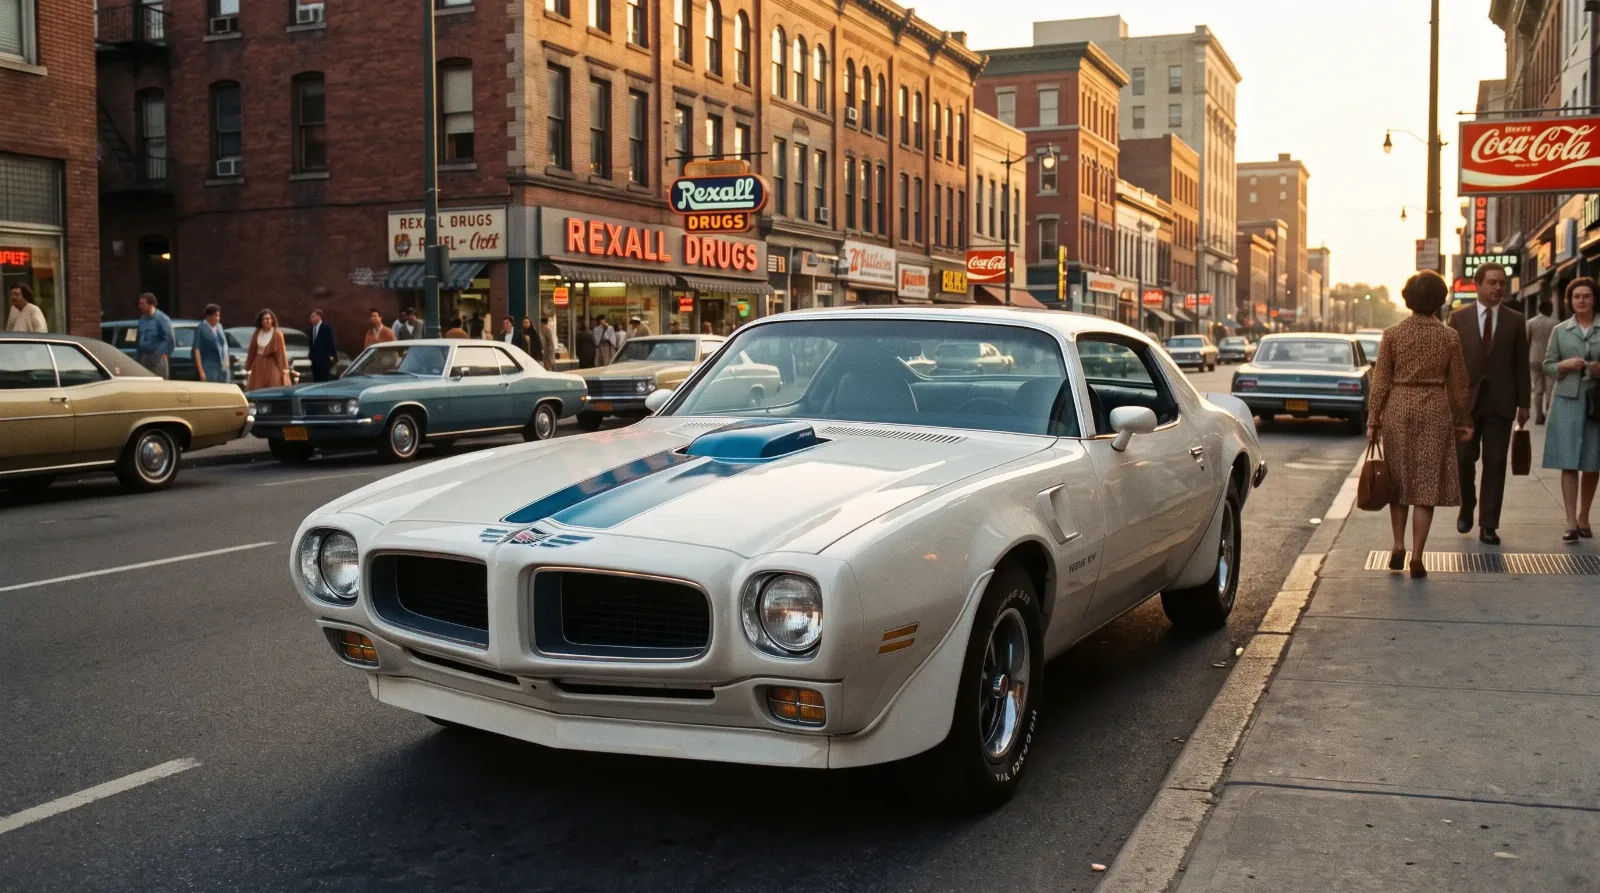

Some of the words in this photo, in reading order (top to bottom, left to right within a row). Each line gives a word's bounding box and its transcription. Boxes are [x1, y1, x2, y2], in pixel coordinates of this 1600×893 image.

[1471, 124, 1597, 163] Coca-Cola
[677, 177, 755, 210] Rexall
[400, 216, 444, 230] REXL
[450, 213, 493, 228] DRUGS
[688, 214, 744, 230] DRUGS
[567, 217, 672, 263] REXALL
[684, 234, 759, 272] DRUGS
